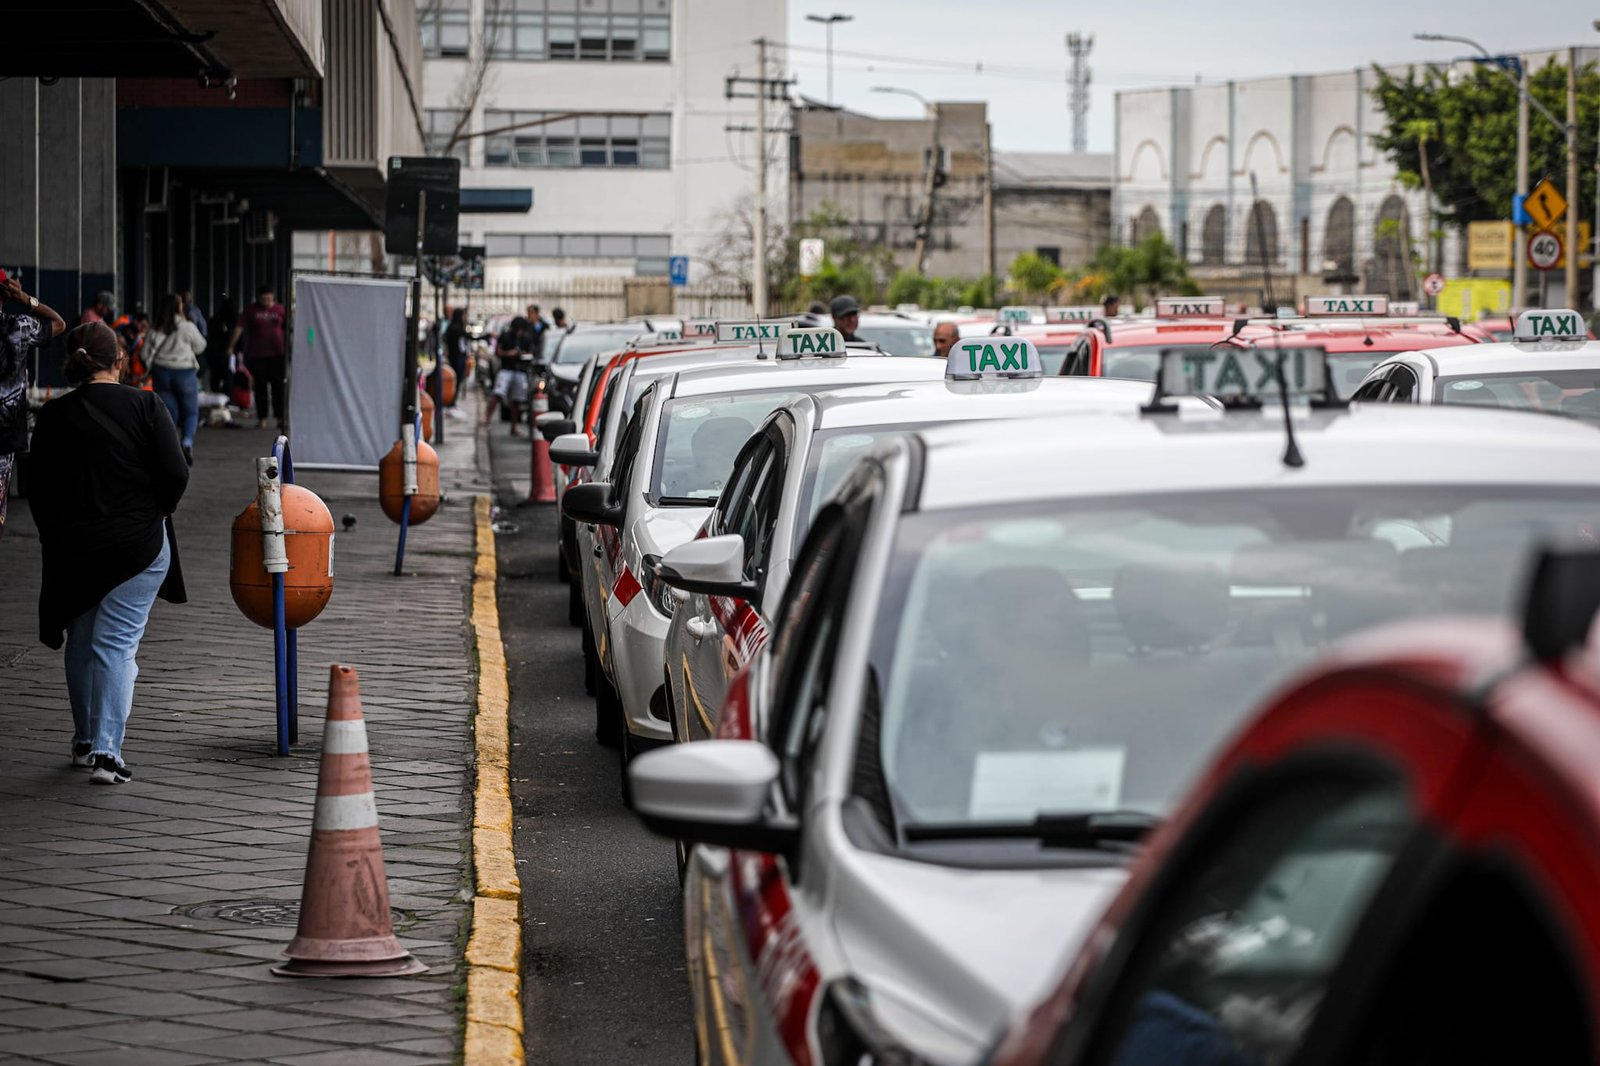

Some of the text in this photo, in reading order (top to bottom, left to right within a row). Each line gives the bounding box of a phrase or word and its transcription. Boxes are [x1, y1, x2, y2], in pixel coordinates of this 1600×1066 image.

[1533, 240, 1556, 257] 40
[1170, 304, 1210, 315] TAXI
[1323, 300, 1374, 313] TAXI
[1058, 311, 1093, 320] TAXI
[695, 324, 716, 335] TA
[732, 325, 780, 339] TAXI
[1528, 315, 1577, 335] TAXI
[788, 332, 836, 353] TAXI
[962, 343, 1029, 372] TAXI
[1181, 350, 1306, 393] TAXI
